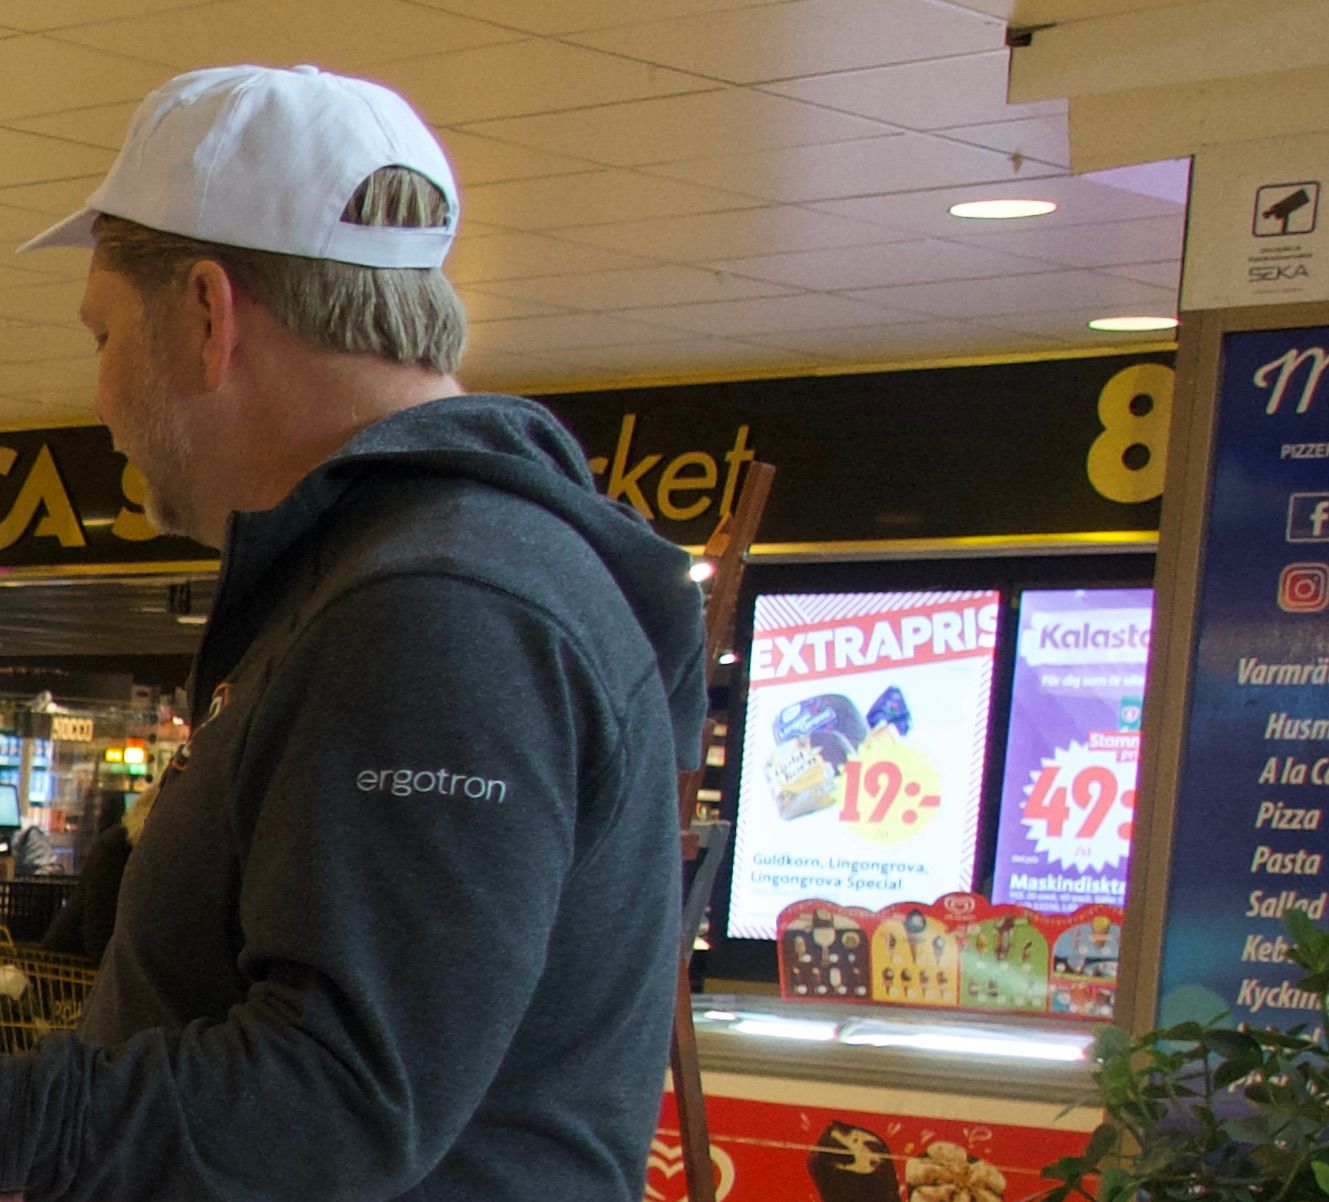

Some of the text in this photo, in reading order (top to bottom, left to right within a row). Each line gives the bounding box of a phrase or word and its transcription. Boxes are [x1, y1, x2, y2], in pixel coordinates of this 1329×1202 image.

[749, 603, 998, 681] EXTRAPRIS
[1238, 656, 1329, 685] Varmrä
[356, 768, 506, 803] ergotron
[1258, 757, 1278, 785] A
[1280, 757, 1307, 785] la
[839, 761, 941, 825] 19:-
[1255, 801, 1322, 830] Pizza
[752, 853, 929, 879] Guldkorn, Lingongrova,
[1251, 846, 1323, 875] Pasta
[751, 872, 902, 891] Lingongrova Special
